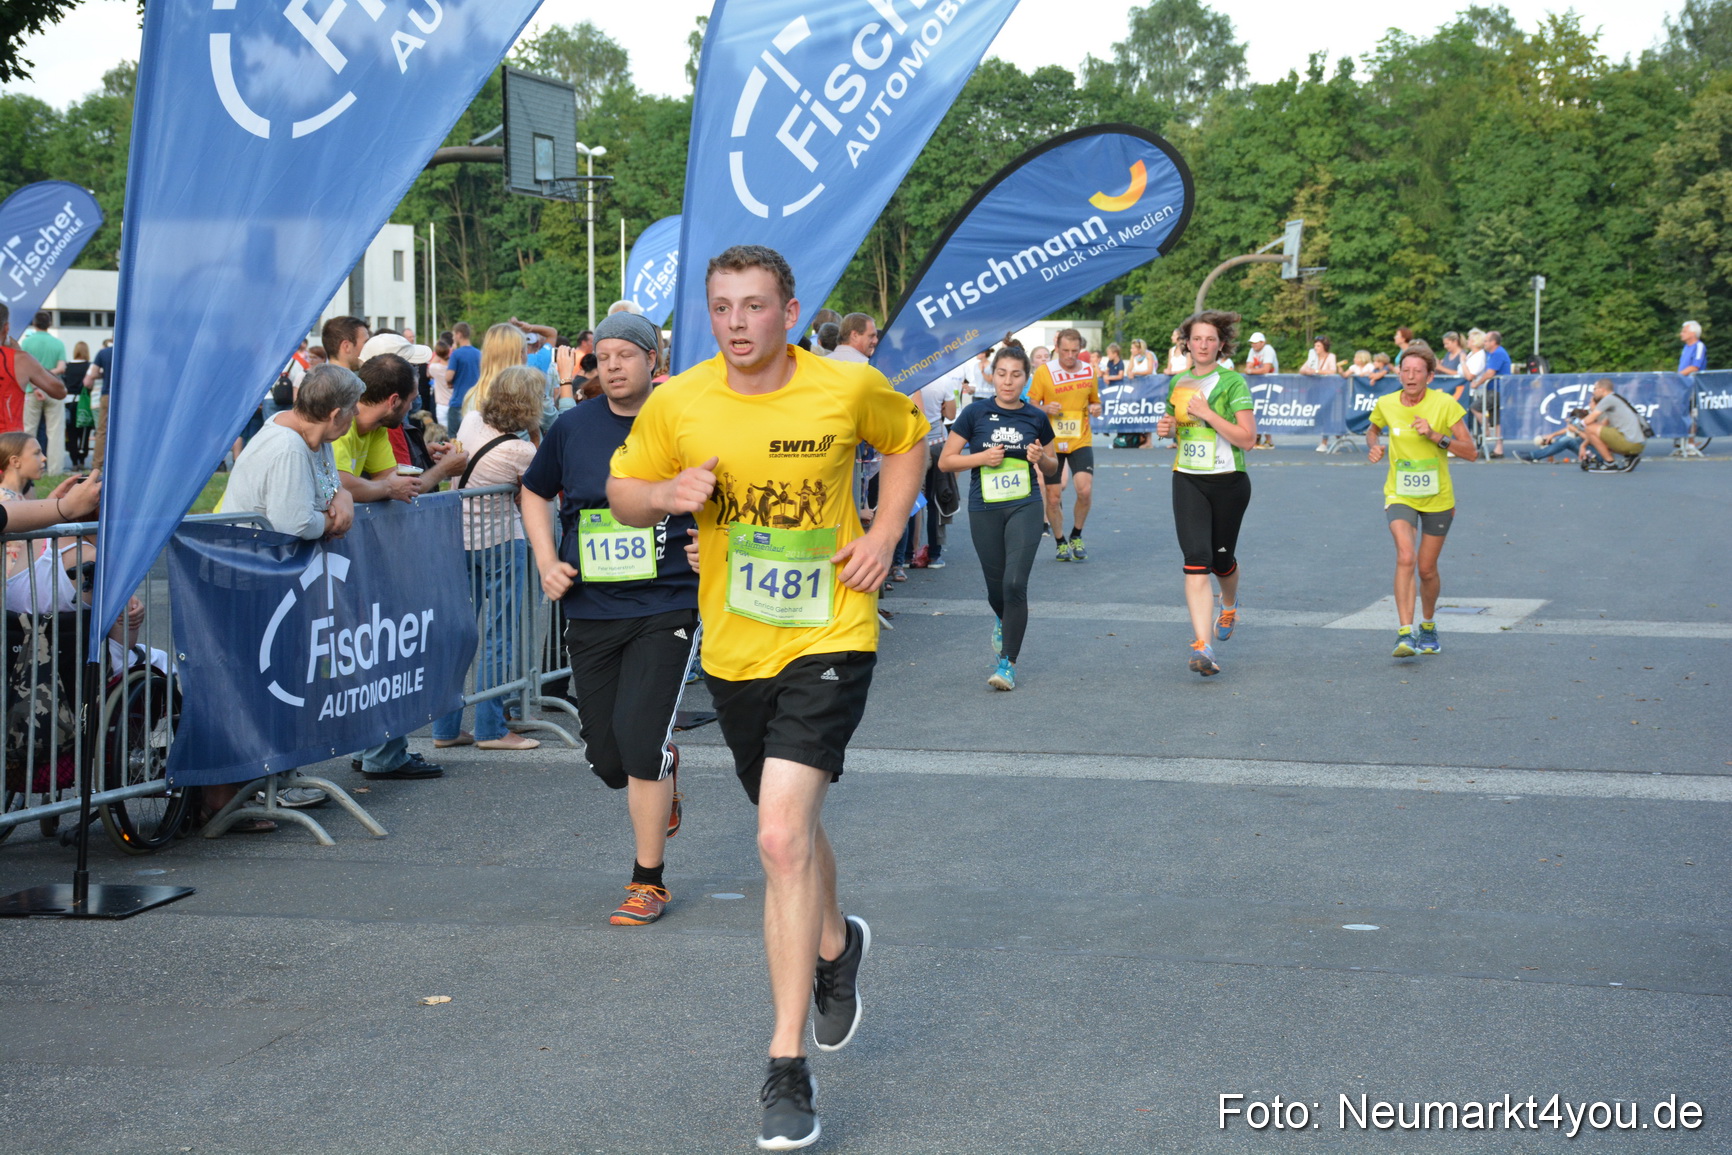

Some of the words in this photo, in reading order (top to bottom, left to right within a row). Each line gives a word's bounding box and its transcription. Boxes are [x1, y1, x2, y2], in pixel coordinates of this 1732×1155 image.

[9, 201, 76, 287] Fischer
[32, 217, 85, 287] AUTOMOBILE
[1040, 251, 1086, 282] Druck
[1089, 238, 1118, 256] und
[1118, 205, 1174, 245] Medien
[916, 215, 1108, 328] Frischmann
[1253, 399, 1320, 416] Fischer
[1057, 422, 1076, 431] 910
[1258, 417, 1315, 427] AUTOMOBILE
[769, 440, 816, 452] swn
[1184, 443, 1206, 457] 993
[992, 474, 1020, 490] 164
[1404, 474, 1430, 487] 599
[586, 536, 646, 561] 1158
[740, 562, 821, 600] 1481
[754, 600, 775, 611] Enrico
[306, 602, 434, 684] Fischer
[318, 667, 425, 721] AUTOMOBILE
